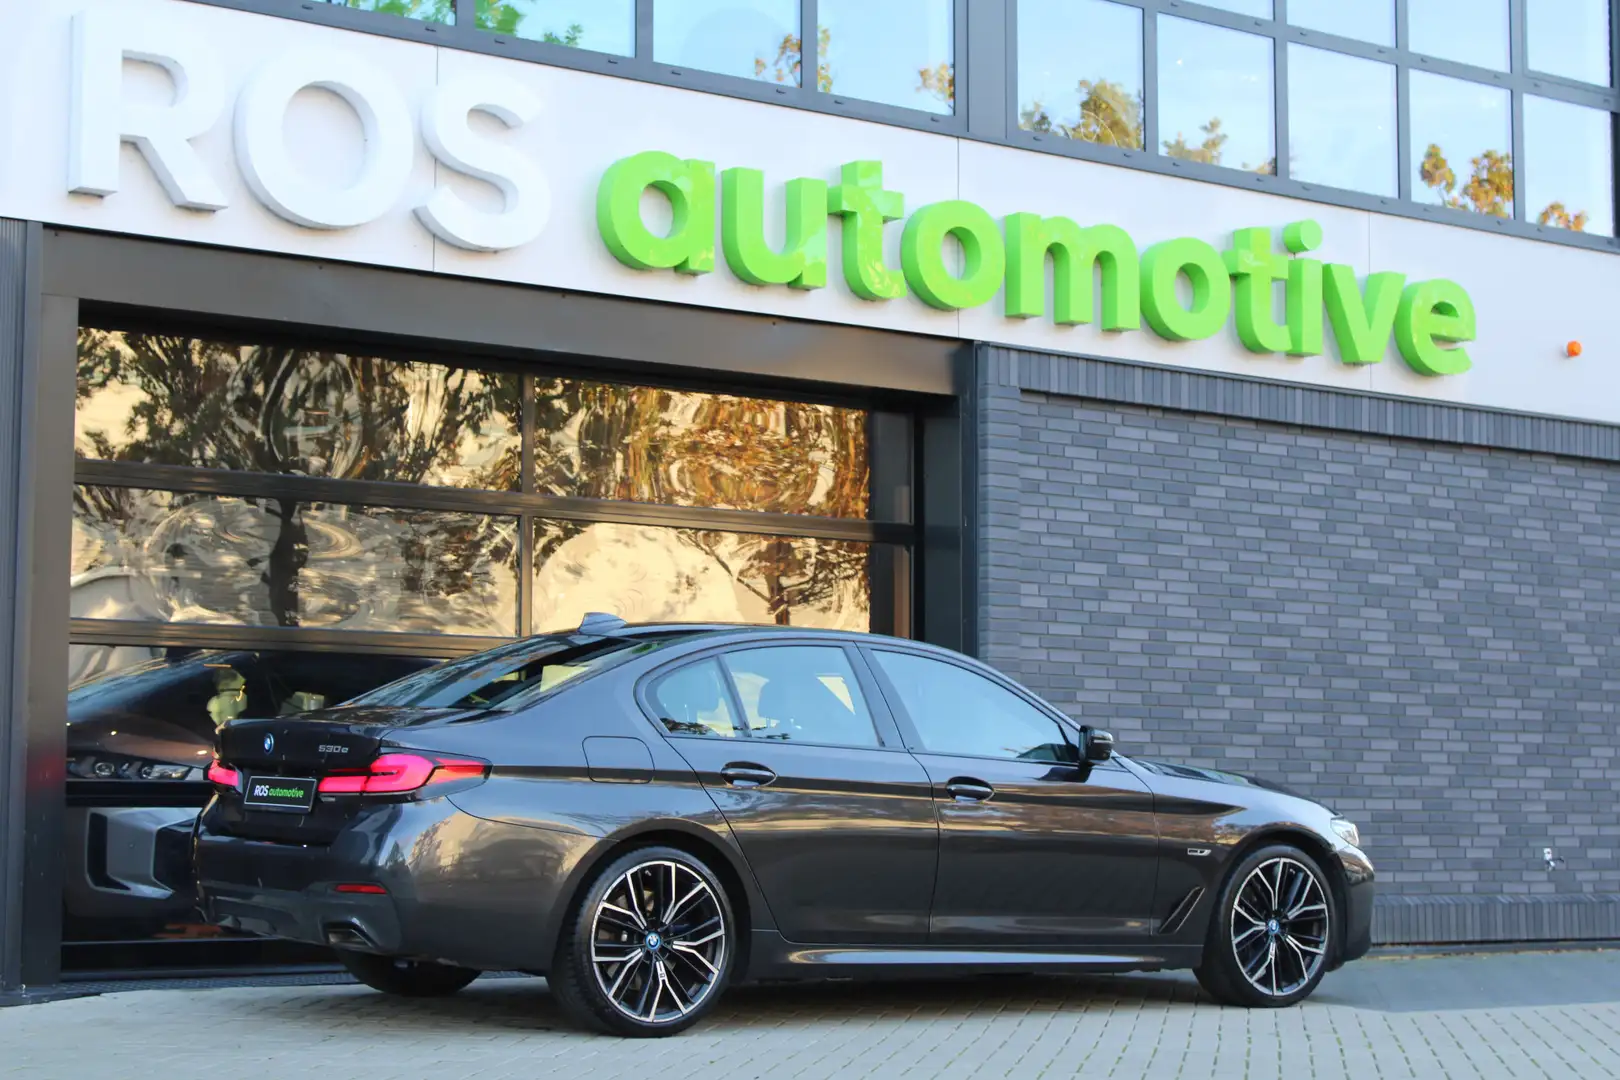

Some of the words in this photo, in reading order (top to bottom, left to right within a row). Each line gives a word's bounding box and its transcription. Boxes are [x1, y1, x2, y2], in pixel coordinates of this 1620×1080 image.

[68, 8, 551, 252] ROS
[597, 151, 1476, 376] automotive
[318, 744, 349, 753] 530e
[253, 785, 269, 797] ROS
[269, 787, 304, 798] automotive
